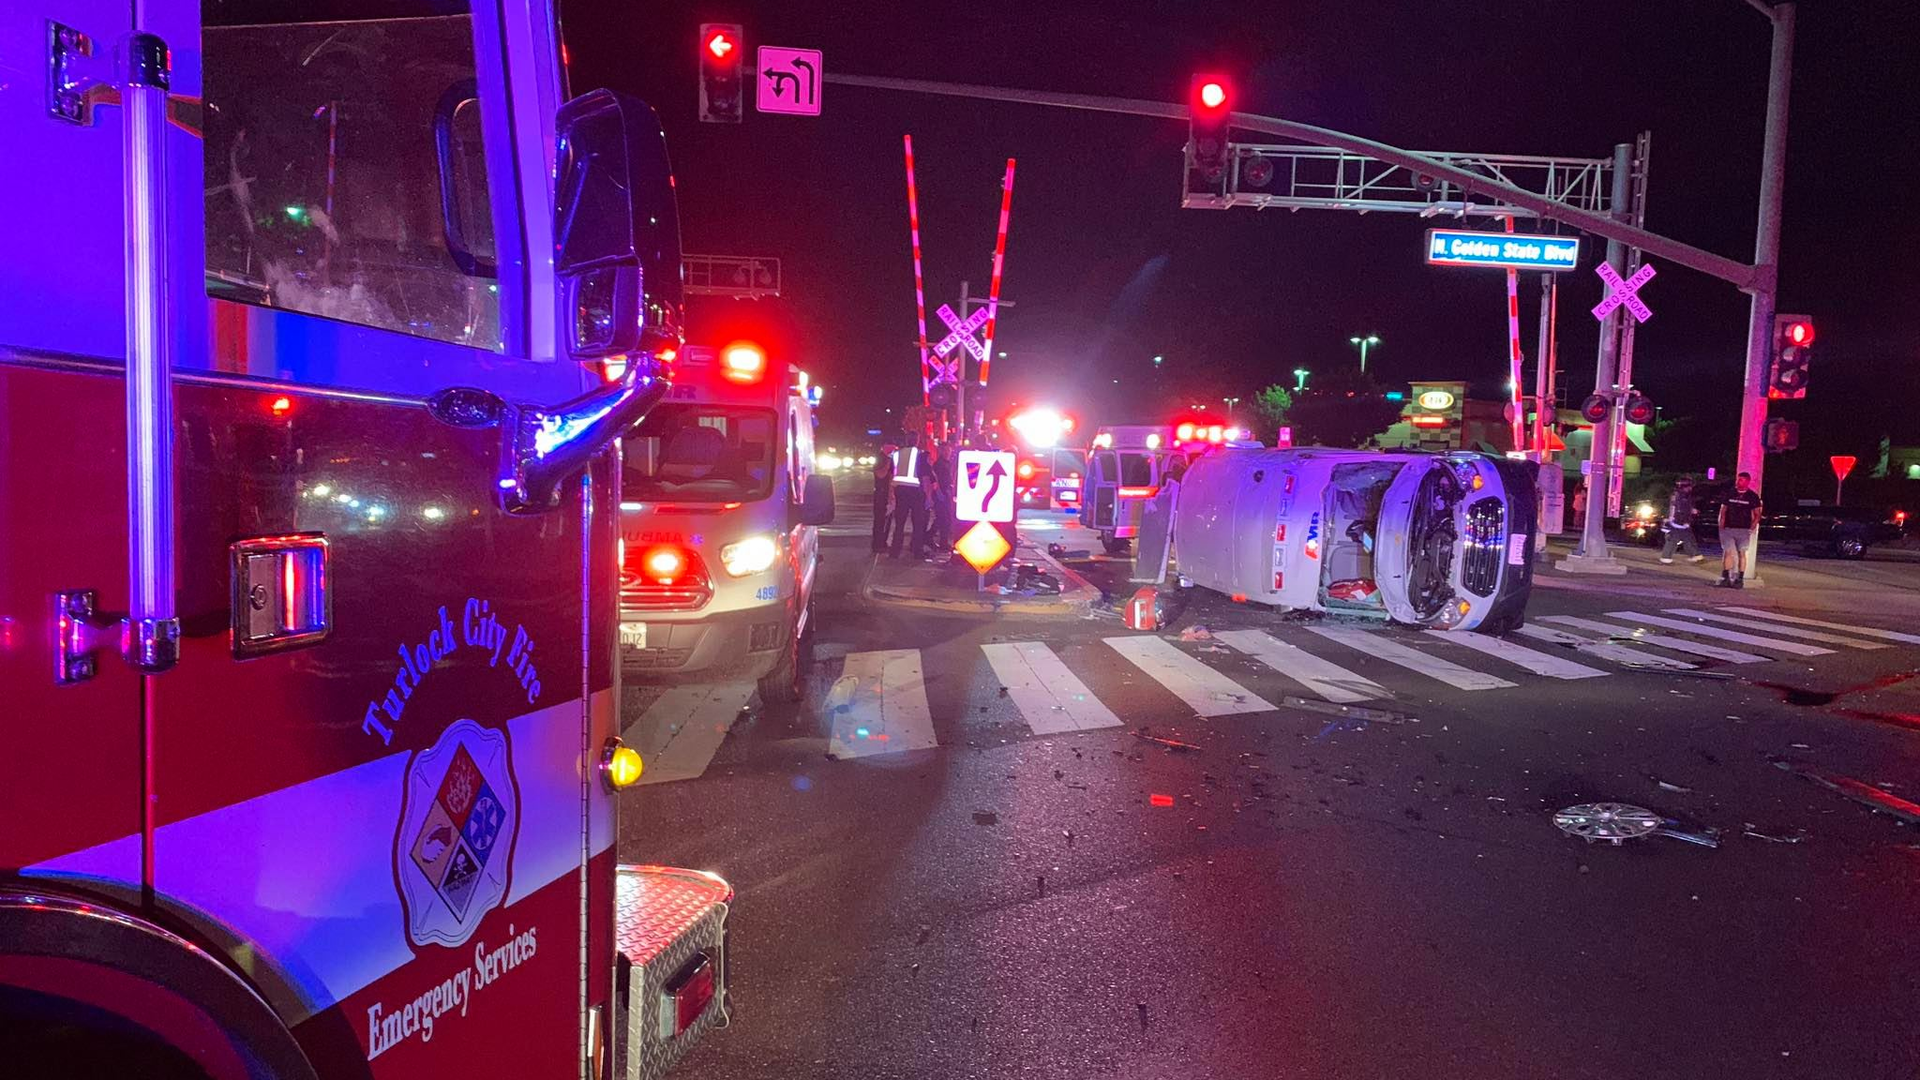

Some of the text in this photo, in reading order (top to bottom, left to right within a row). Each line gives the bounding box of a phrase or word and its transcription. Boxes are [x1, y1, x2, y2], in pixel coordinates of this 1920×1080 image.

[1451, 238, 1499, 257] Golden
[1503, 241, 1540, 260] State
[1544, 244, 1575, 261] Blvd
[362, 597, 541, 746] Turlock City Fire
[367, 923, 537, 1061] Emergency Services
